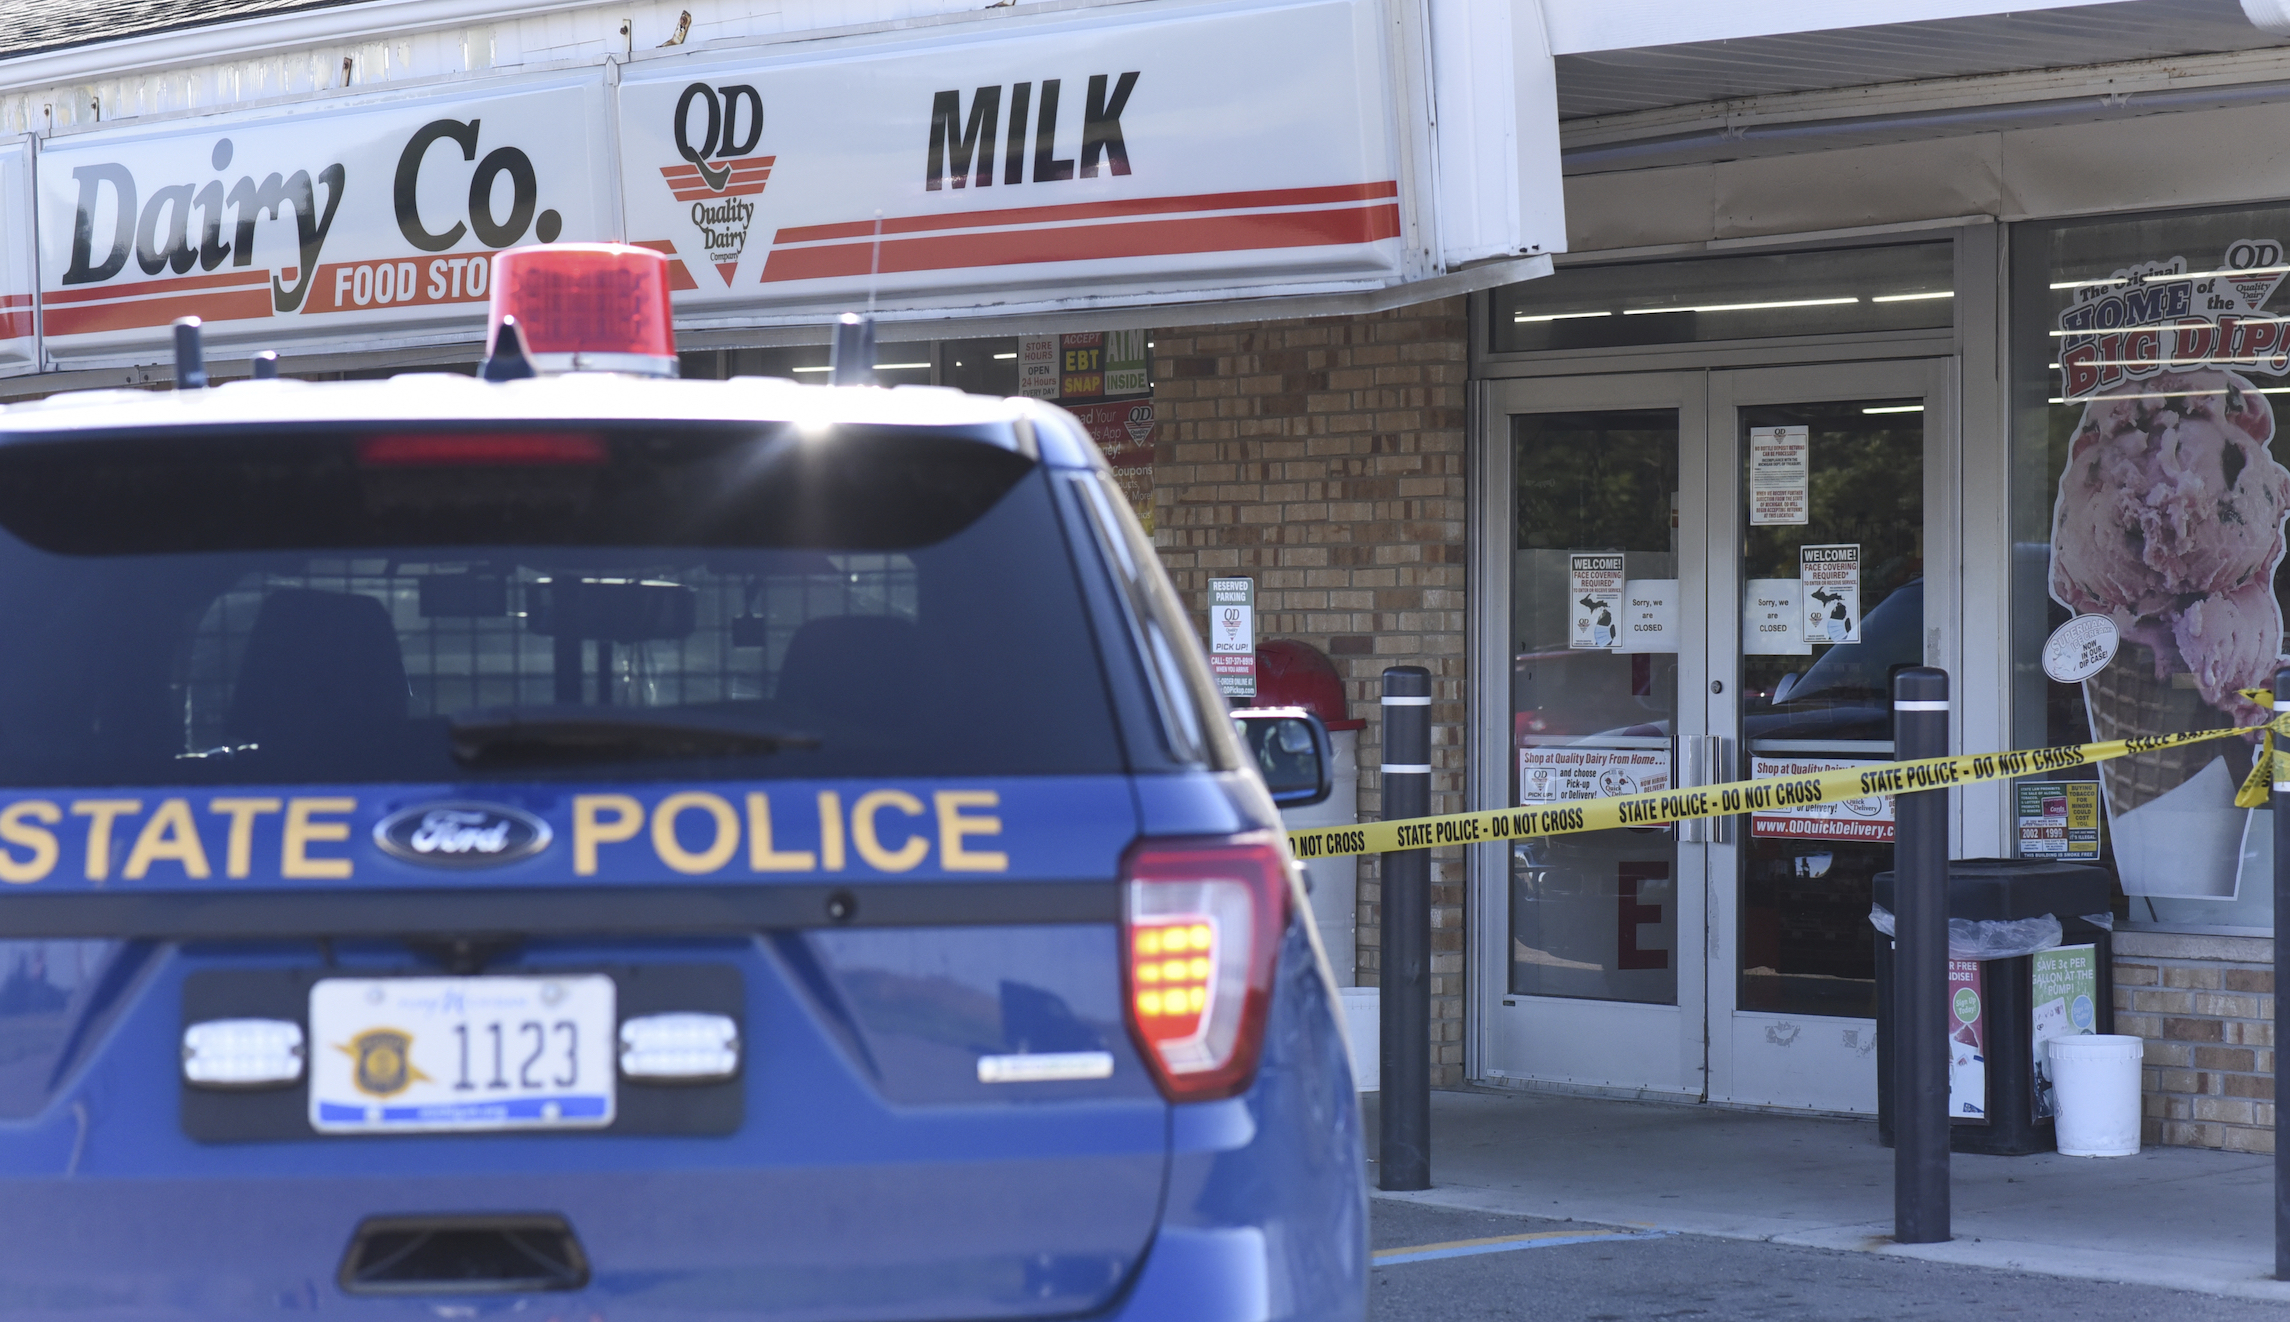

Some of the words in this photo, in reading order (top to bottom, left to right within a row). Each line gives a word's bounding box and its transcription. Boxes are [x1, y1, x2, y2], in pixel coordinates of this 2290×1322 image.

[674, 82, 764, 190] QD
[926, 71, 1141, 191] MILK
[62, 138, 345, 312] Dairy
[394, 119, 562, 252] Co.
[692, 197, 754, 232] Quality
[704, 227, 747, 254] Dairy
[710, 252, 738, 262] Company
[2229, 244, 2279, 278] QD
[335, 262, 417, 306] FOOD
[427, 256, 494, 300] STO
[2080, 285, 2109, 302] The
[2114, 263, 2179, 290] Original
[2236, 281, 2271, 295] Quality
[2207, 295, 2234, 310] the
[2242, 291, 2266, 300] Dairy
[2063, 281, 2192, 350] HOME
[2197, 279, 2215, 294] of
[1063, 332, 1100, 344] ACCEPT
[1025, 341, 1053, 351] STORE
[1024, 350, 1053, 361] HOURS
[1065, 349, 1099, 372] EBT
[2063, 323, 2160, 398] BIG
[2171, 315, 2290, 370] DIP!
[1028, 365, 1050, 376] OPEN
[1021, 377, 1032, 388] 24
[1034, 376, 1057, 387] Hours
[1064, 376, 1100, 393] SNAP
[1106, 373, 1146, 390] INSIDE
[1042, 387, 1055, 396] DAY
[1096, 408, 1116, 423] Your
[1129, 407, 1152, 426] QD
[1103, 426, 1121, 442] App
[1112, 465, 1153, 478] Coupons
[1804, 549, 1857, 561] WELCOME!
[1574, 558, 1621, 570] WELCOME!
[1804, 563, 1821, 571] FACE
[1823, 562, 1856, 571] COVERING
[1574, 571, 1589, 579] FACE
[1590, 571, 1622, 579] COVERING
[1213, 581, 1248, 591] RESERVED
[1216, 591, 1246, 602] PARKING
[1632, 599, 1652, 607] Sorry,
[1758, 599, 1777, 607] Sorry,
[1224, 608, 1240, 625] QD
[1634, 624, 1662, 632] CLOSED
[1760, 624, 1787, 632] CLOSED
[2050, 619, 2105, 656] SUPERMAN
[2082, 639, 2097, 651] NOW
[2081, 652, 2088, 660] IN
[2090, 645, 2102, 656] OUR
[2079, 659, 2089, 669] DIP
[2090, 651, 2108, 664] CASE!
[1524, 752, 1544, 765] Shop
[1545, 754, 1554, 764] at
[1555, 753, 1584, 765] Quality
[1585, 753, 1608, 766] Dairy
[1609, 754, 1629, 764] From
[1631, 754, 1665, 765] Home...
[1533, 769, 1548, 782] QD
[1560, 768, 1572, 777] and
[1574, 768, 1596, 777] choose
[1757, 762, 1778, 776] Shop
[1780, 763, 1789, 774] at
[1791, 763, 1824, 775] Quality
[1860, 767, 1902, 795] STATE
[1907, 762, 1959, 788] POLICE
[1973, 756, 1995, 779] DO
[1999, 752, 2028, 776] NOT
[2032, 745, 2085, 770] CROSS
[1566, 779, 1590, 790] Pick-up
[1605, 785, 1622, 793] Quick
[1560, 791, 1568, 799] or
[1569, 790, 1597, 799] Delivery!
[1618, 798, 1658, 823] STATE
[1661, 793, 1708, 818] POLICE
[1722, 788, 1741, 812] DO
[1745, 785, 1772, 808] NOT
[1776, 779, 1822, 806] CROSS
[1854, 804, 1877, 813] Delivery
[411, 809, 510, 853] Ford
[1397, 823, 1433, 847] STATE
[1436, 819, 1480, 843] POLICE
[1492, 816, 1509, 837] DO
[1513, 812, 1537, 835] NOT
[1541, 807, 1584, 833] CROSS
[2022, 828, 2038, 839] 2002
[2046, 828, 2063, 838] 1999
[0, 797, 358, 884] STATE
[573, 789, 1009, 876] POLICE
[1300, 834, 1322, 857] NOT
[1327, 830, 1365, 855] CROSS
[1957, 961, 1977, 971] FREE
[2037, 960, 2056, 972] SAVE
[2070, 957, 2086, 968] PER
[2032, 972, 2063, 984] GALLON
[2064, 970, 2076, 980] AT
[2076, 969, 2094, 979] THE
[2048, 984, 2074, 995] PUMP!
[1955, 998, 1968, 1008] Sign
[1968, 997, 1976, 1006] Up
[1958, 1005, 1977, 1015] Today!
[453, 1020, 578, 1091] 1123
